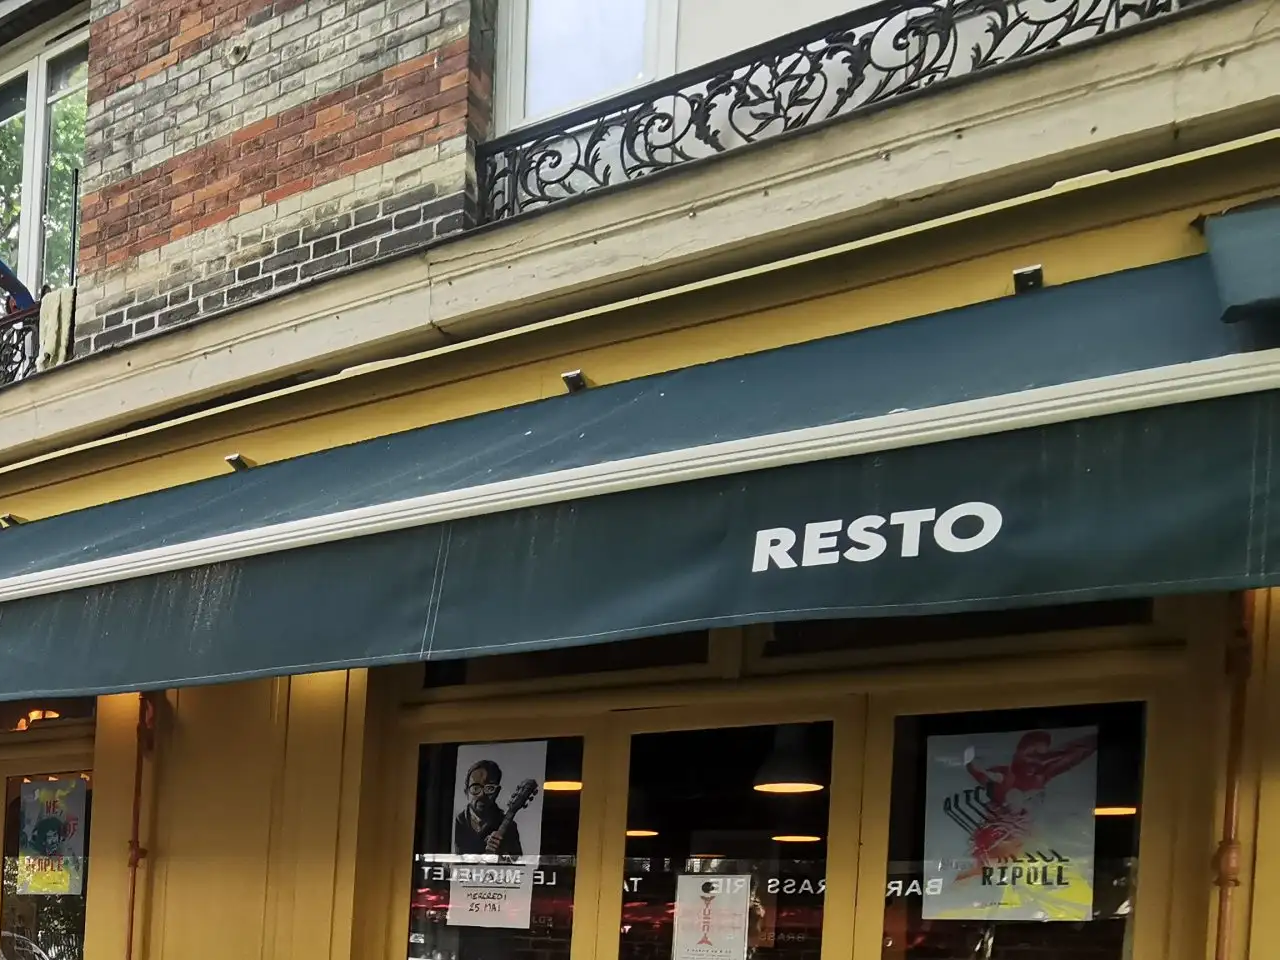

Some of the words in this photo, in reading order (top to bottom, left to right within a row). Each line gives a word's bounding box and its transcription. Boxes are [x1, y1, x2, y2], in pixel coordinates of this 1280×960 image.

[751, 501, 1003, 572] RESTO
[981, 865, 1069, 886] RIPOLL
[466, 892, 507, 901] MERCREDI
[468, 902, 480, 912] 25
[483, 902, 501, 912] MAI
